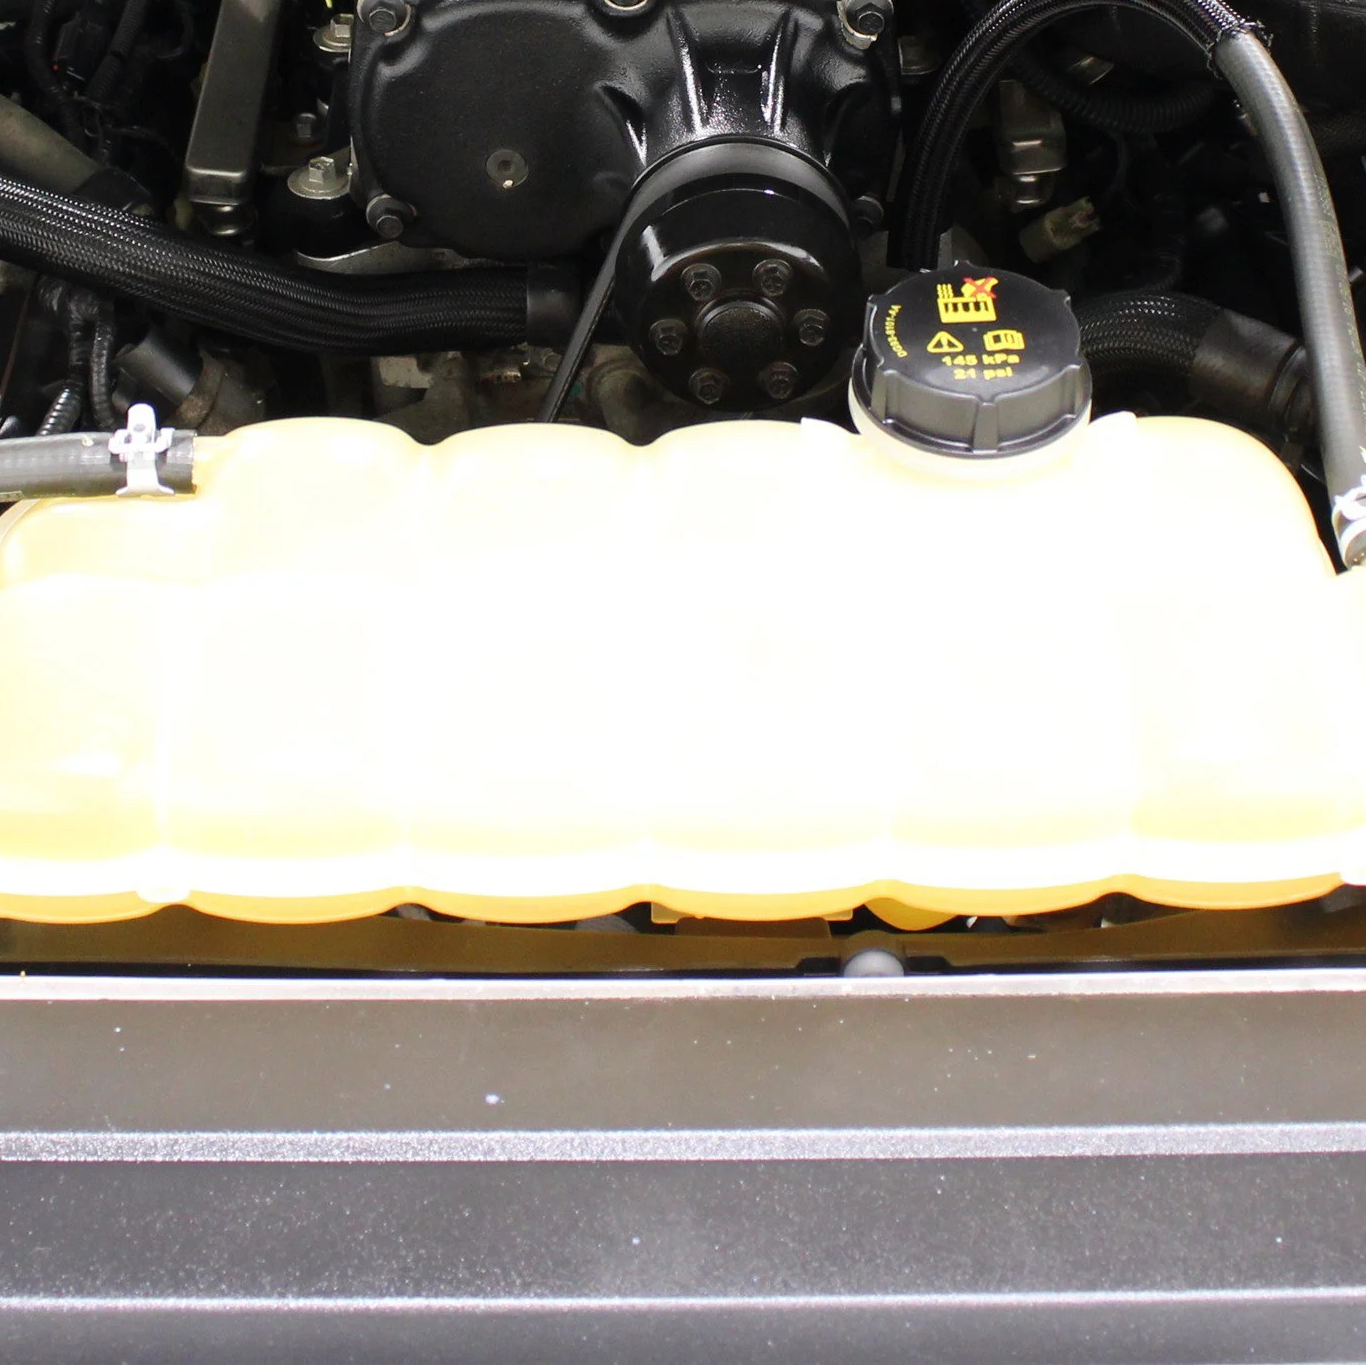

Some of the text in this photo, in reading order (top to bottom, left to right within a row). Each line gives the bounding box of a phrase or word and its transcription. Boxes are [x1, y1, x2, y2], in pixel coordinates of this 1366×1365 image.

[941, 352, 1021, 367] 145 kPa
[952, 366, 1014, 381] 21 psi
